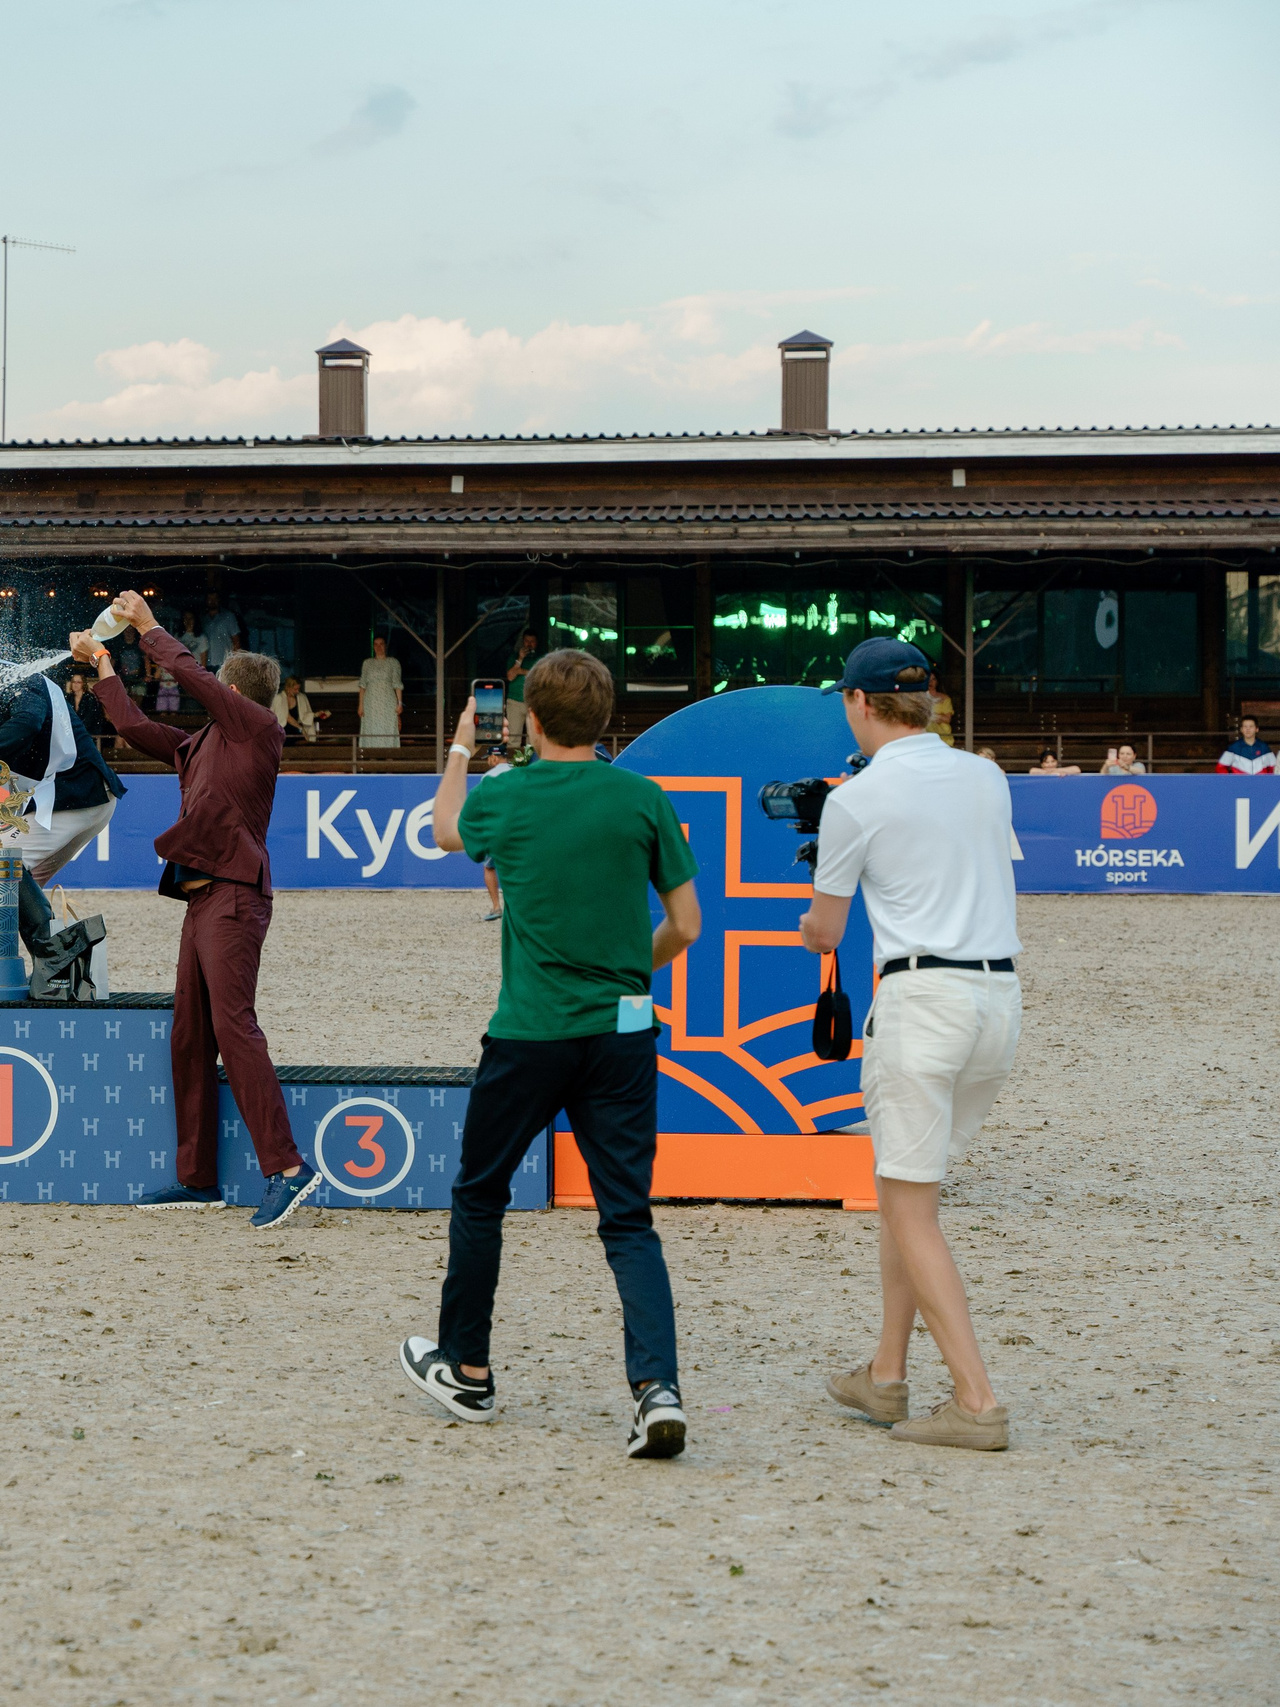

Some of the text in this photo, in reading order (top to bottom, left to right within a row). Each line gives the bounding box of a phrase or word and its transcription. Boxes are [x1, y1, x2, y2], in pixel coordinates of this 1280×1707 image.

[1075, 844, 1185, 867] HÓRSEKA
[1106, 870, 1148, 885] sport
[344, 1116, 386, 1178] 3
